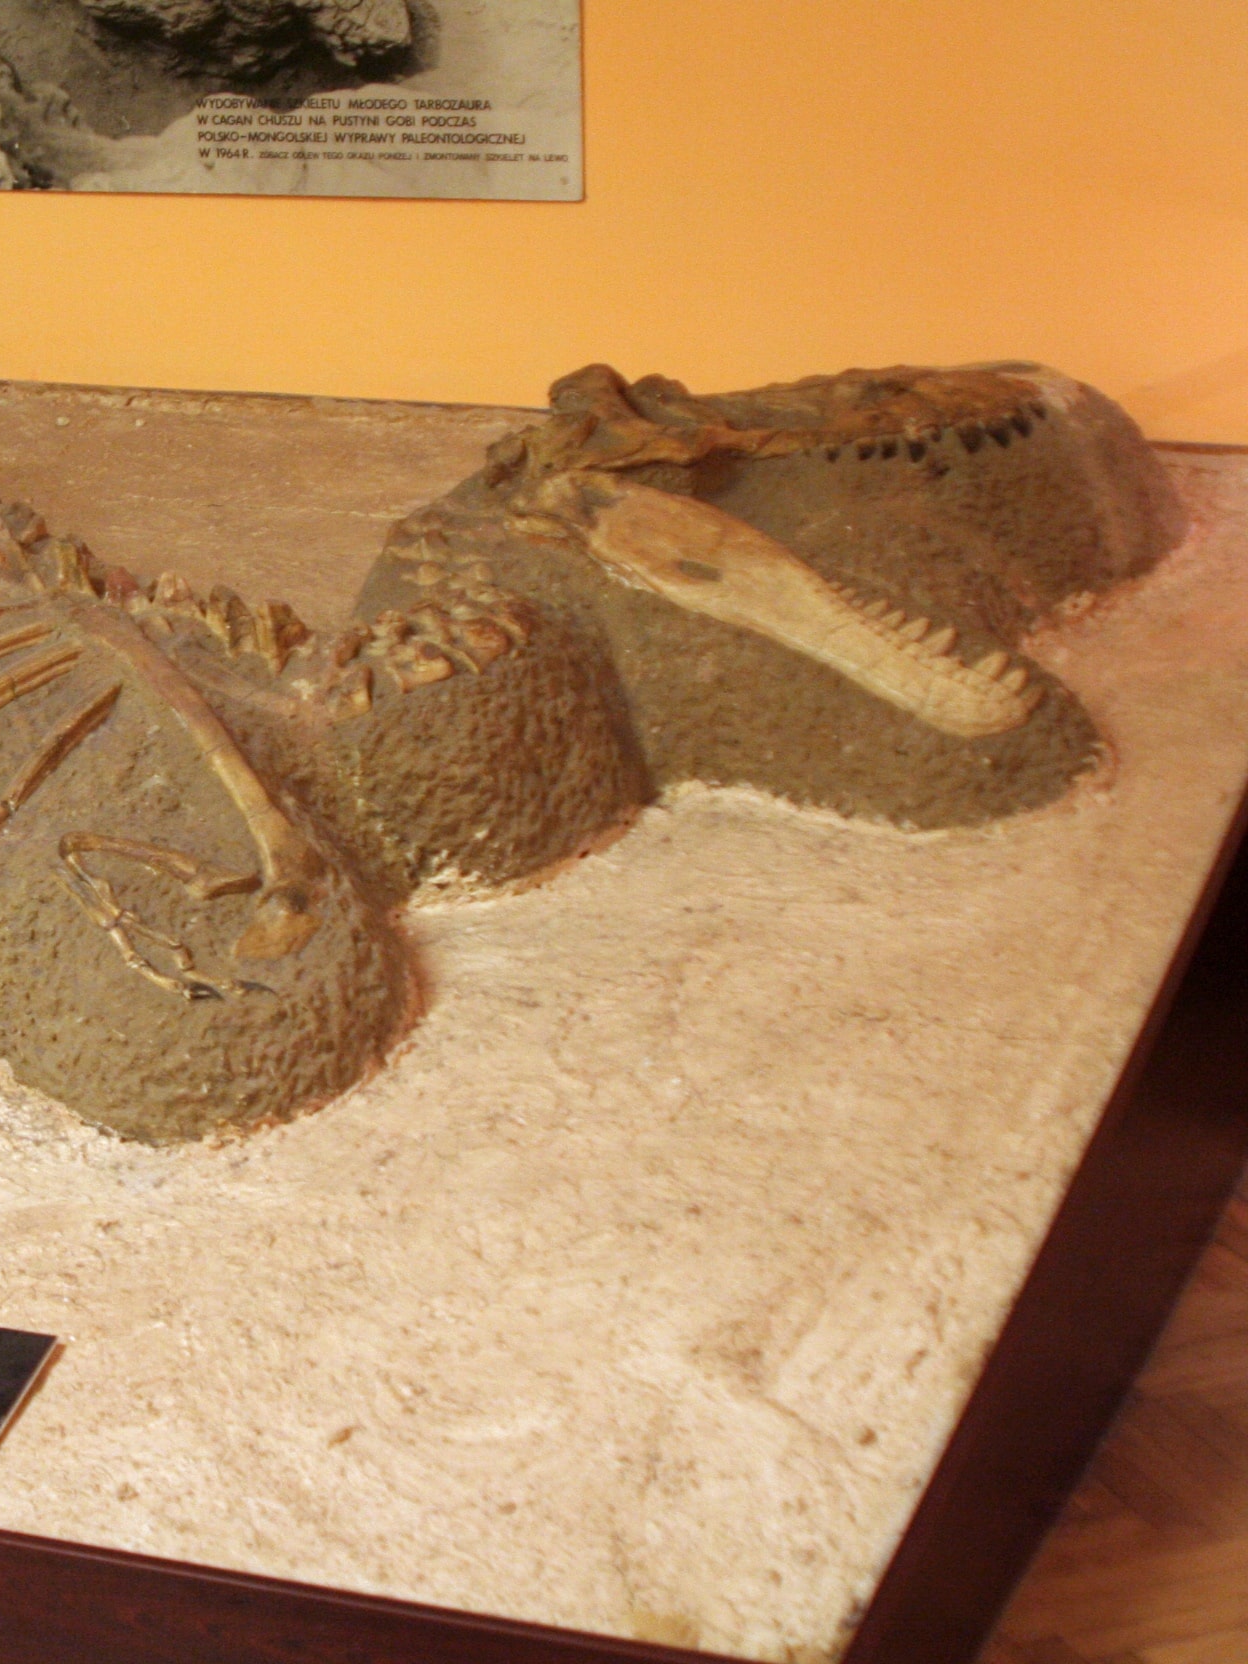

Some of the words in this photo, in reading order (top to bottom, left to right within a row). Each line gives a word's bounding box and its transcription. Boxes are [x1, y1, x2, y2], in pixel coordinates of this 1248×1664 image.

[348, 99, 407, 110] MŁODEGO
[414, 99, 492, 111] TARBOZAURA
[197, 115, 208, 125] W
[212, 115, 252, 126] CAGAN
[258, 115, 302, 126] CHUSZU
[309, 115, 326, 126] NA
[333, 115, 380, 126] PUSTYNI
[385, 116, 416, 127] GOBI
[421, 116, 477, 128] PODCZAS
[334, 132, 396, 144] WYPRAWY
[402, 133, 526, 145] PALEONTOLOGICZNEJ
[199, 148, 211, 159] W
